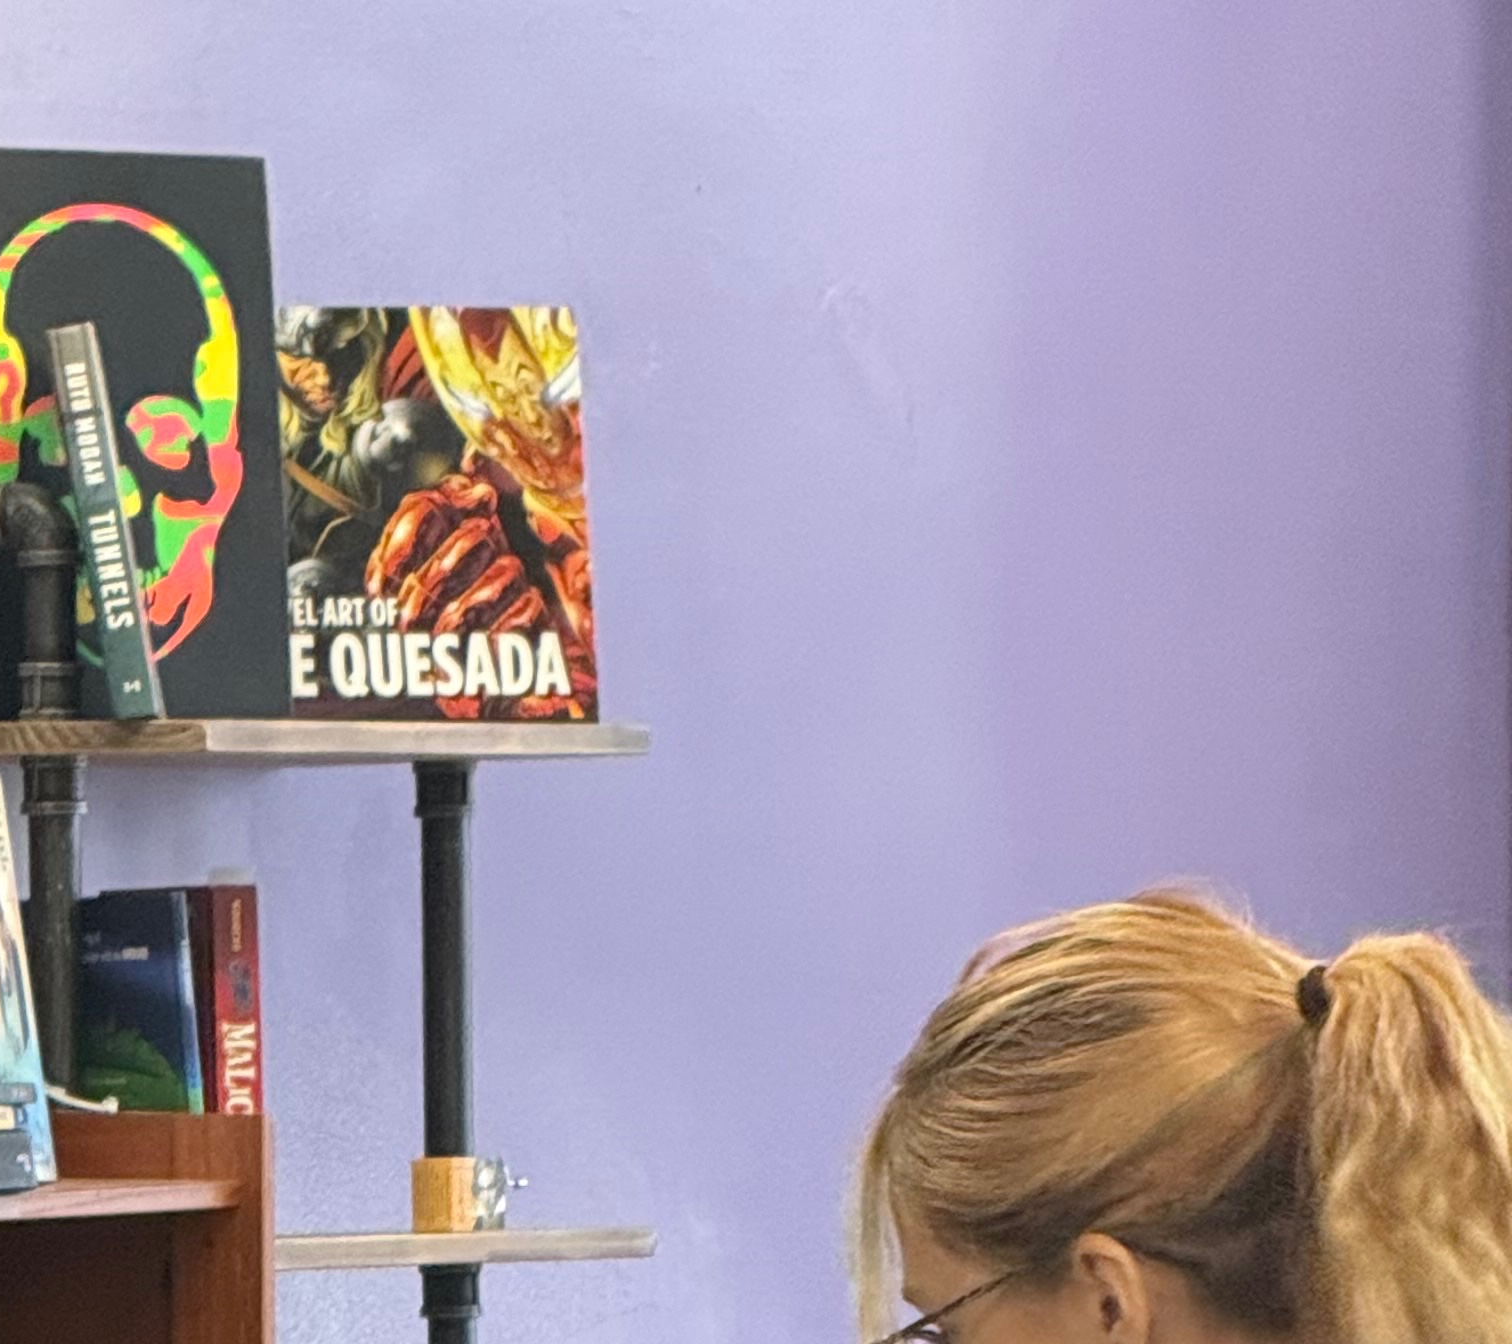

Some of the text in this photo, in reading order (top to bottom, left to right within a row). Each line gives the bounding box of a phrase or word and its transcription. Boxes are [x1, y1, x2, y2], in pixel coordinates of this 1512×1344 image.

[64, 361, 135, 631] RUTU MODAN TUNNELS
[322, 597, 365, 628] ART
[370, 597, 399, 628] OF
[329, 632, 571, 698] QUESADA
[222, 1020, 258, 1115] MALIC
